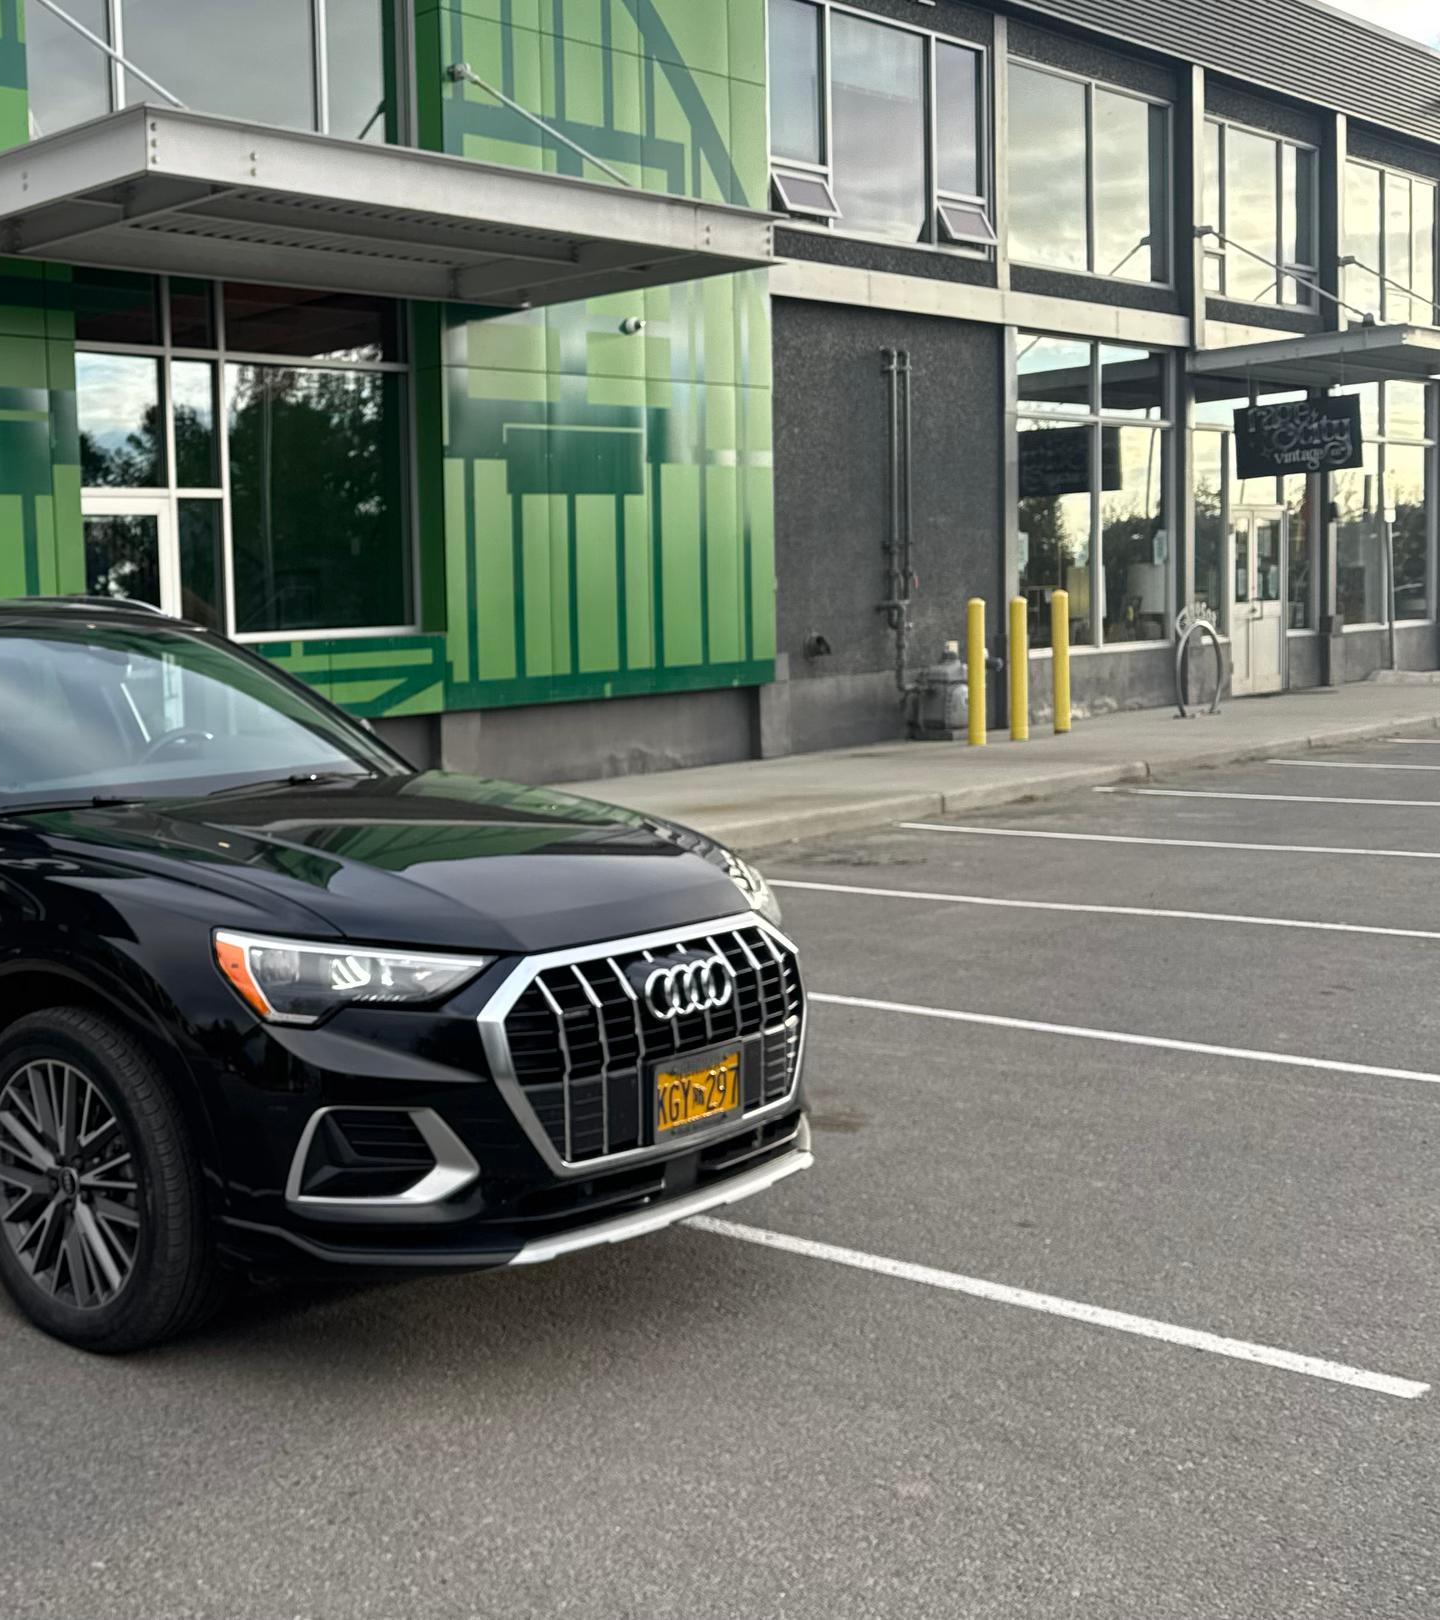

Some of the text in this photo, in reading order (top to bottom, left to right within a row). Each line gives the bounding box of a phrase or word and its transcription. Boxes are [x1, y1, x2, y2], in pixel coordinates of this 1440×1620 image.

[1274, 447, 1325, 470] vintage
[657, 1079, 691, 1125] KGY
[705, 1066, 739, 1111] 297
